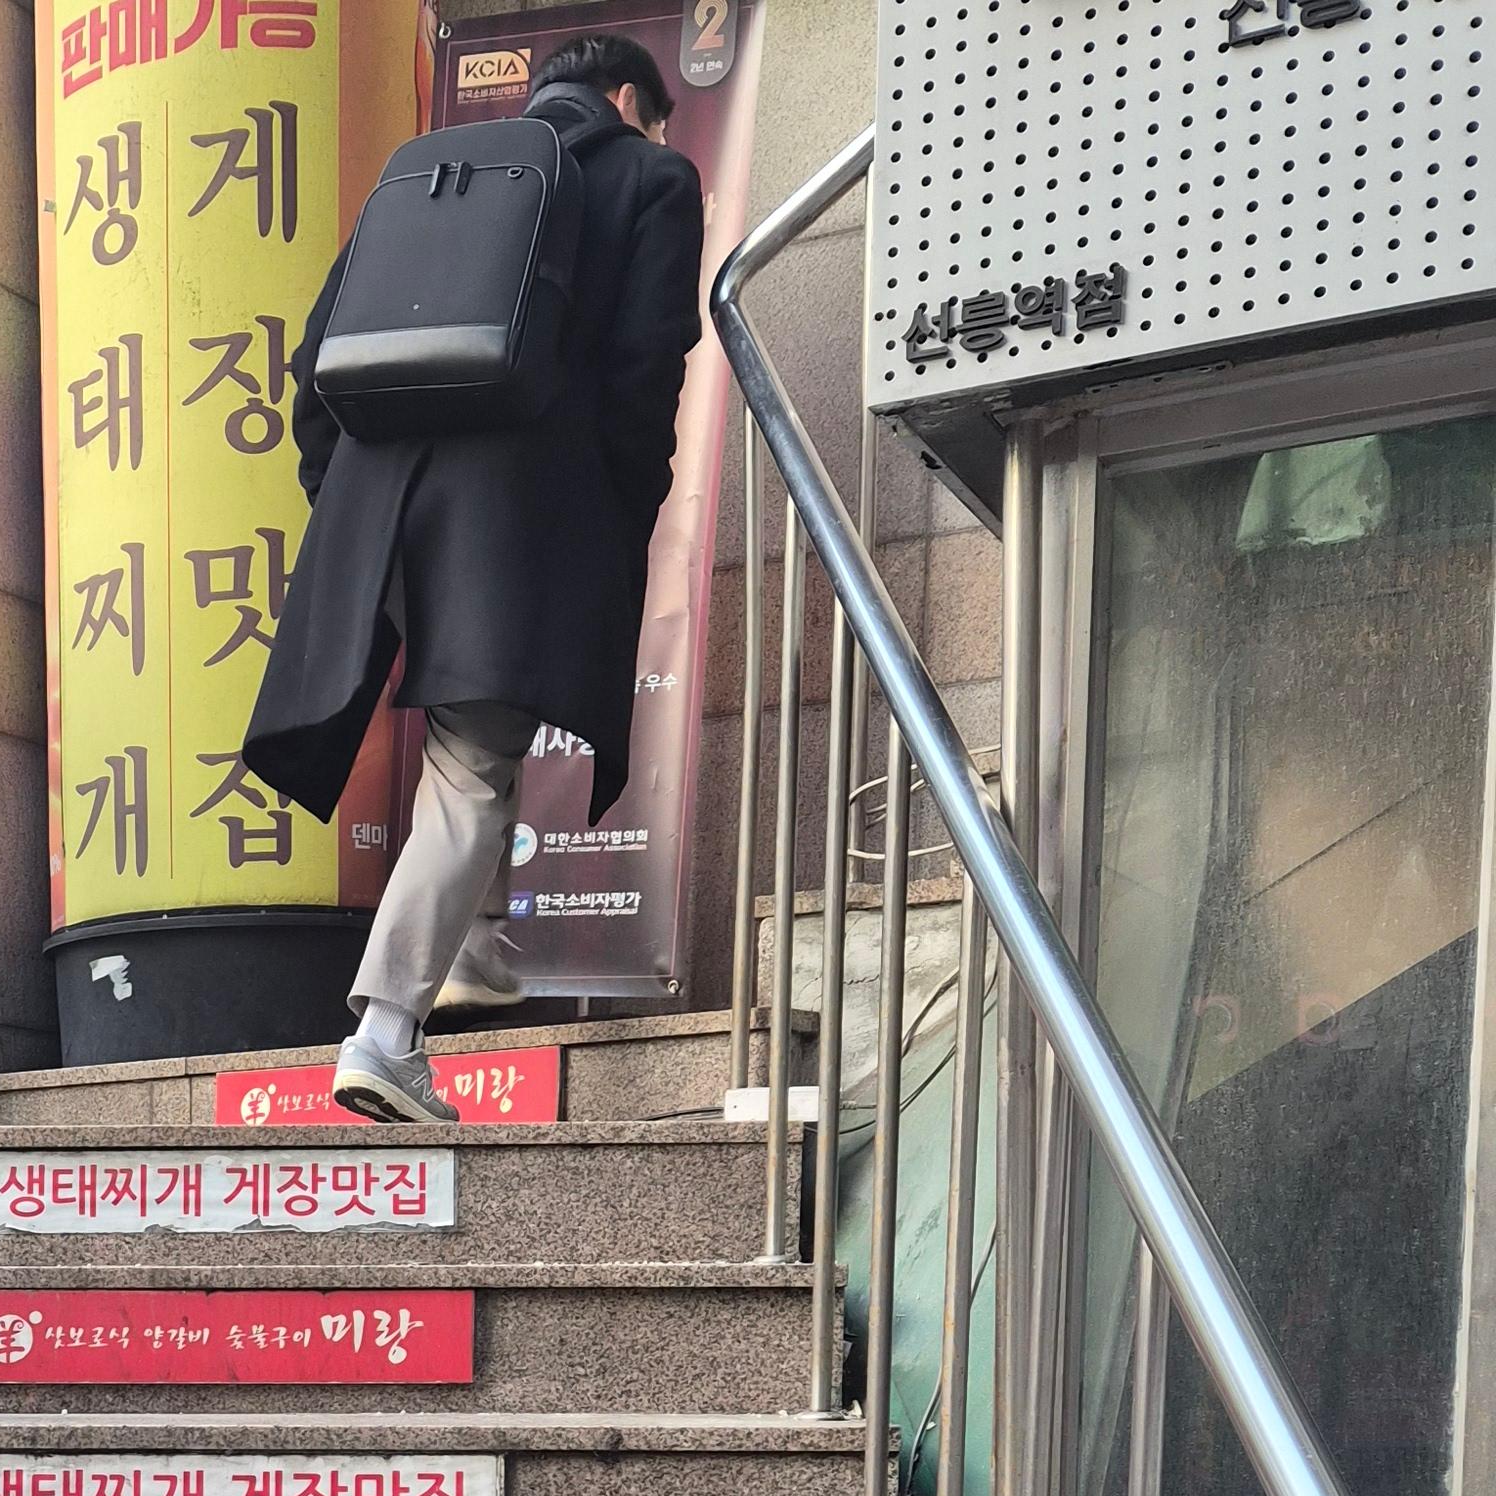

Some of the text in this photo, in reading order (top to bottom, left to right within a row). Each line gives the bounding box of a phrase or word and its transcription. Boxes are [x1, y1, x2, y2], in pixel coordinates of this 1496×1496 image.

[691, 0, 728, 50] 2
[465, 58, 520, 79] KCIA
[901, 265, 1128, 363] 선릉역점
[350, 823, 388, 851] 덴마
[544, 829, 649, 846] 대한소비자협의회
[535, 892, 642, 909] 한국소비자평가
[561, 907, 600, 917] Customer
[455, 1066, 525, 1113] 미랑
[0, 1163, 427, 1218] 생태찌개 게장맛집
[143, 1326, 209, 1350] 양갈비
[225, 1326, 311, 1350] 숯불구이
[321, 1308, 425, 1365] 미랑
